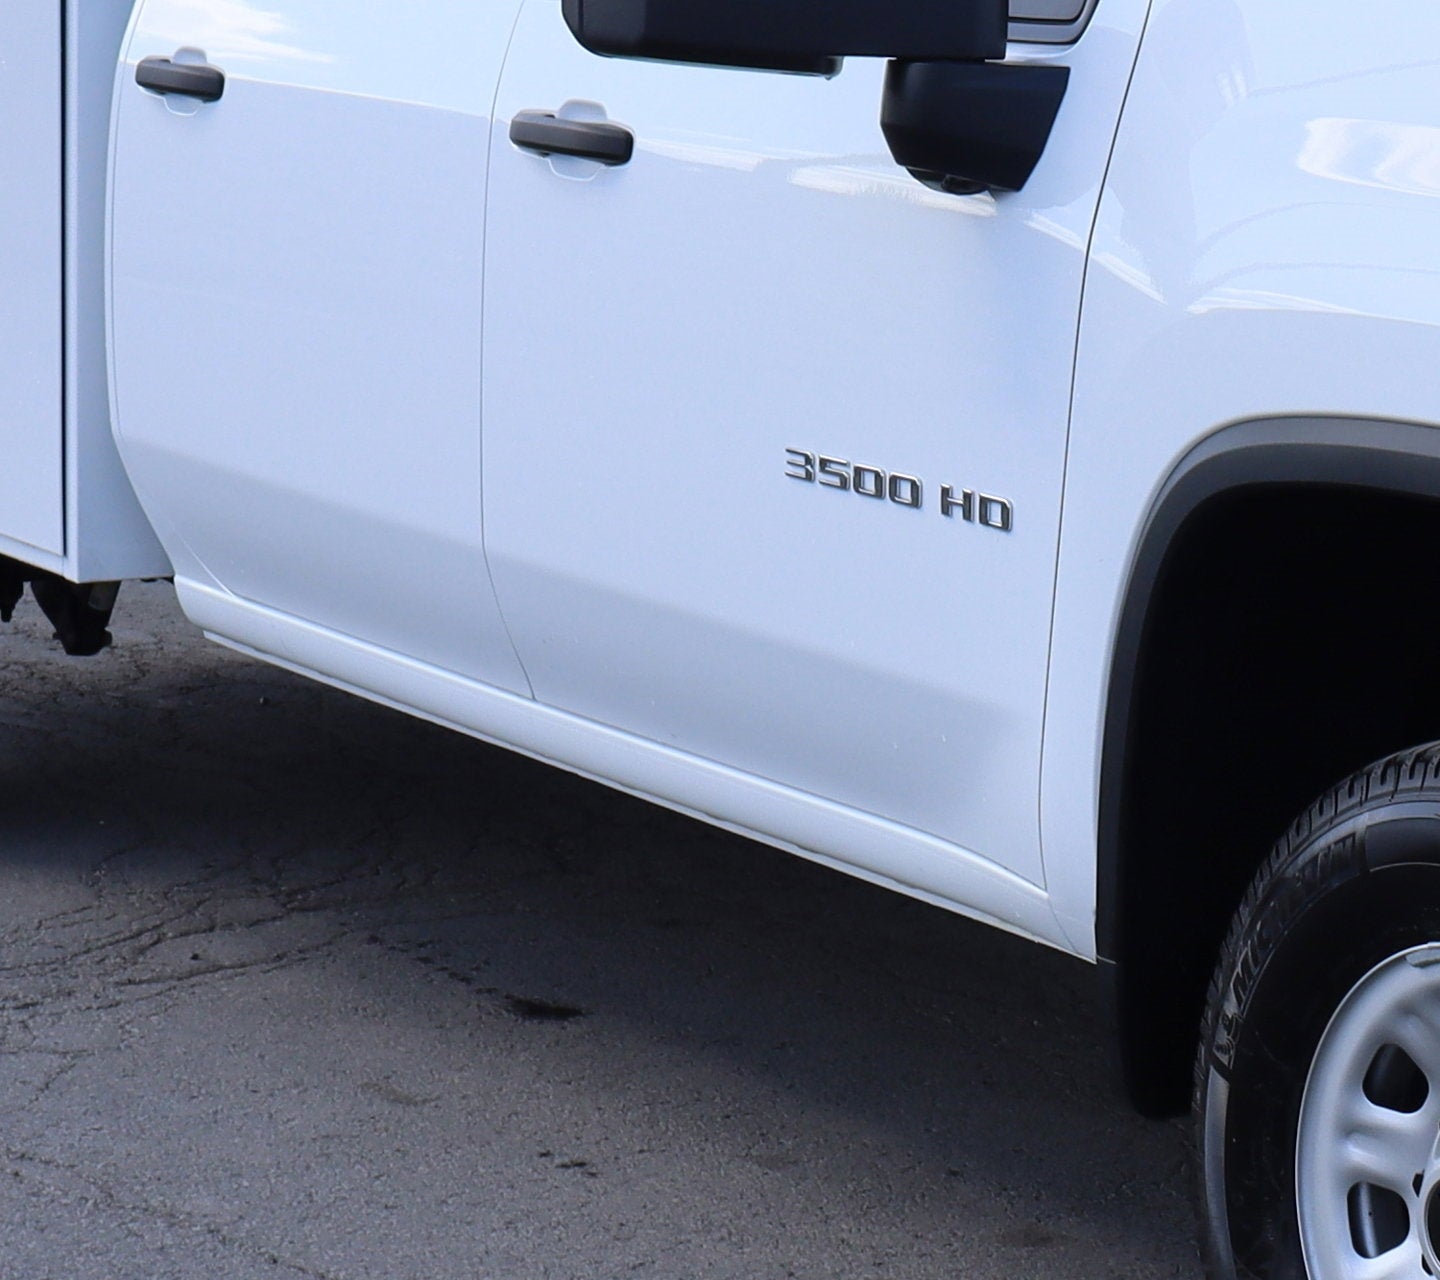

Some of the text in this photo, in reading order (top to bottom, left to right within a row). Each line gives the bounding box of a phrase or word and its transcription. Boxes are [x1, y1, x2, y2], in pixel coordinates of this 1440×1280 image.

[785, 447, 1014, 532] 3500 HD
[1226, 828, 1358, 1013] MICIN
